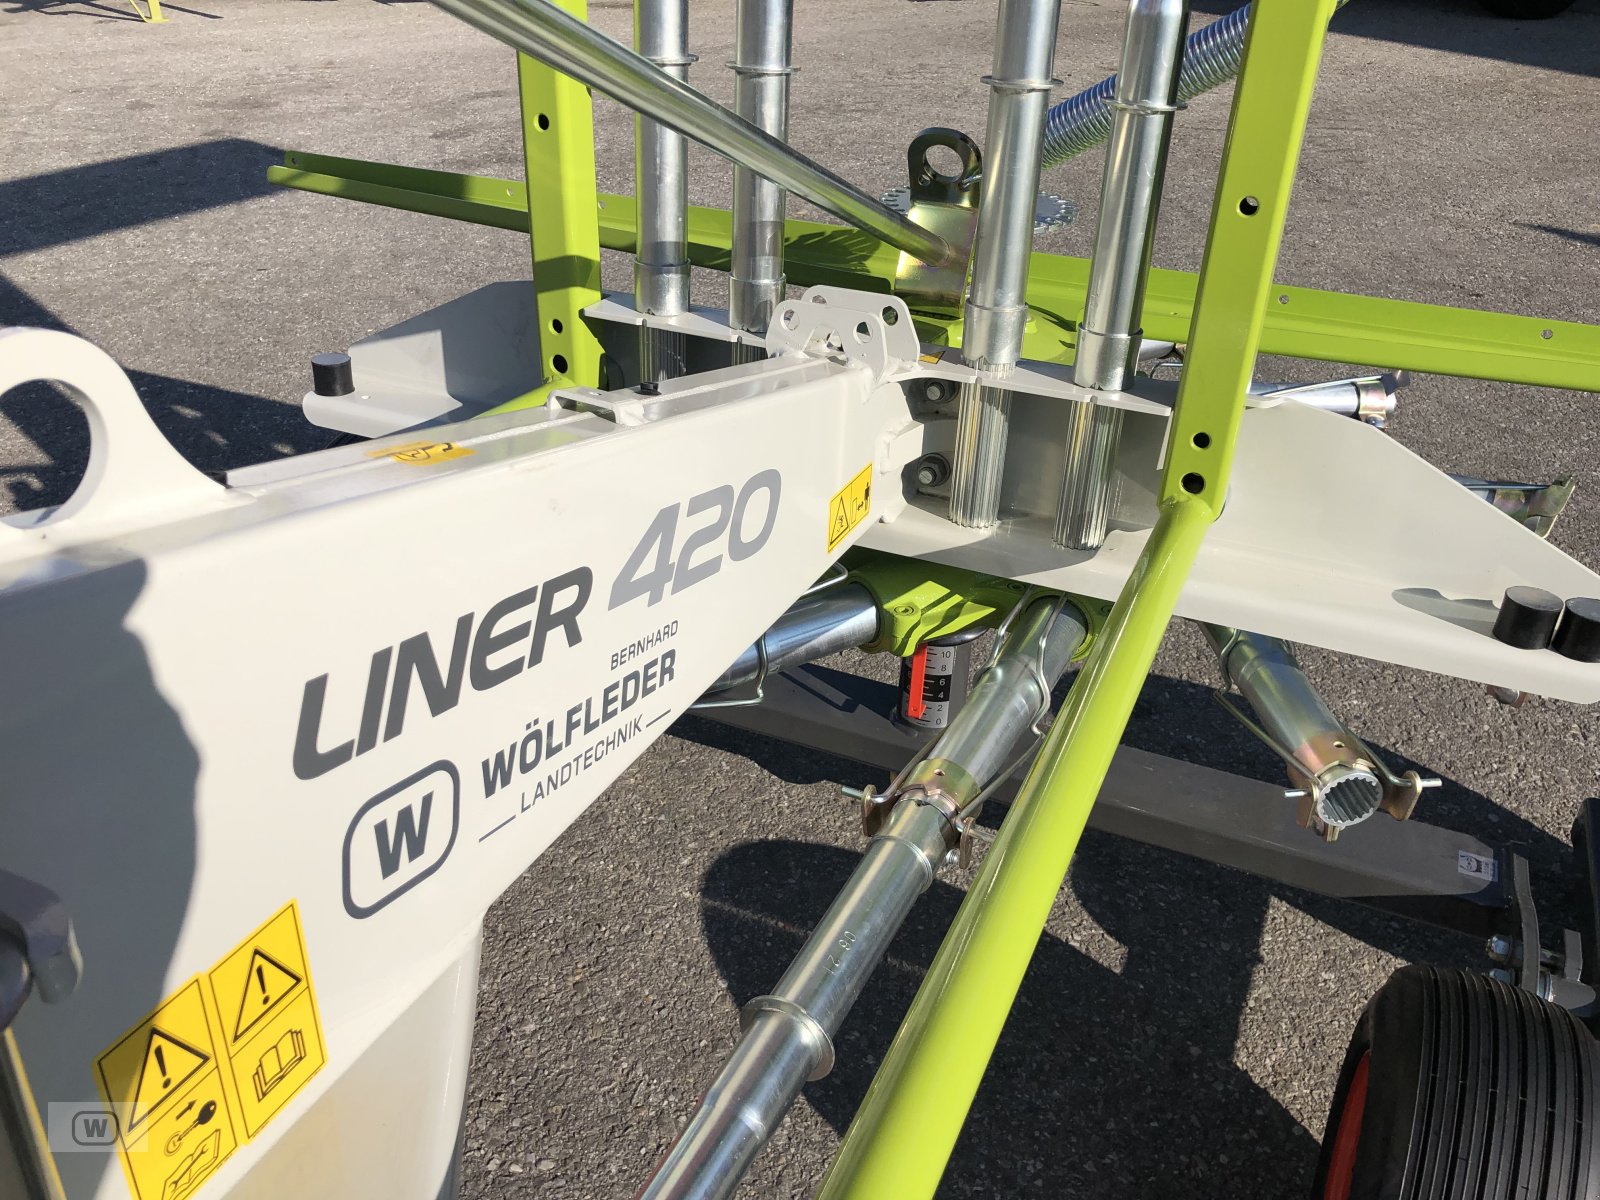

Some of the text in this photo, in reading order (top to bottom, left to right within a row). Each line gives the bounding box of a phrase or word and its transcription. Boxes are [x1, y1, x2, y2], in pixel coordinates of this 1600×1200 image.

[293, 468, 782, 781] LINER 420
[610, 620, 679, 671] BERNHARD
[941, 651, 951, 659] 10
[481, 648, 677, 800] WÖLFLEDER
[938, 691, 944, 699] 4
[519, 713, 644, 815] LANDTECHNIK
[373, 790, 434, 881] W
